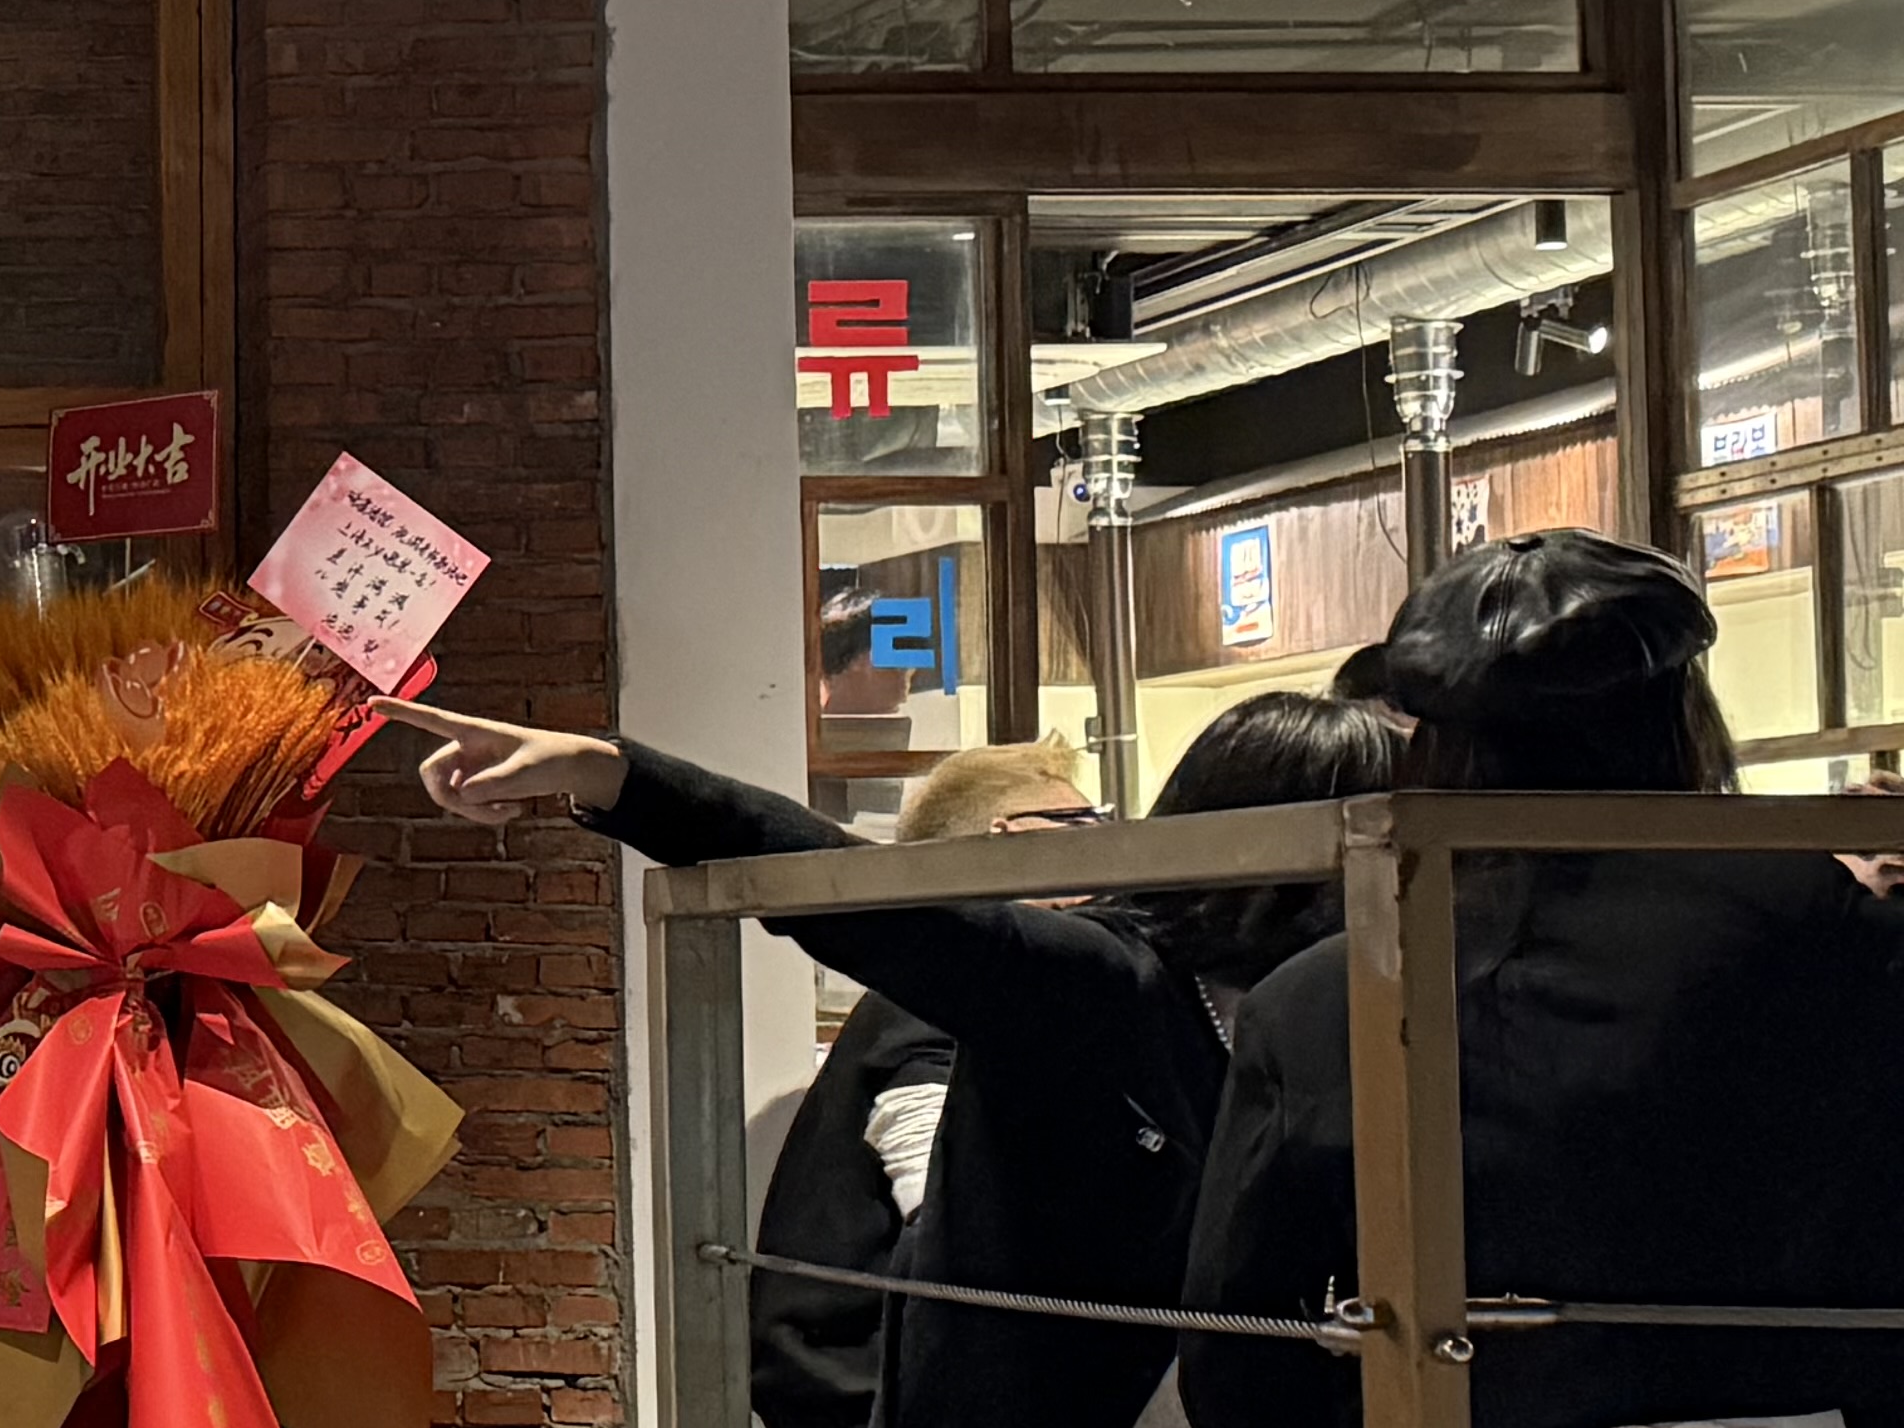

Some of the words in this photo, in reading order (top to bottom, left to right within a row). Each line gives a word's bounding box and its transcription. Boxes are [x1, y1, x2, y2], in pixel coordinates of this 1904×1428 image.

[797, 279, 919, 419] 류
[66, 422, 195, 517] 开业大吉
[870, 557, 957, 696] 리
